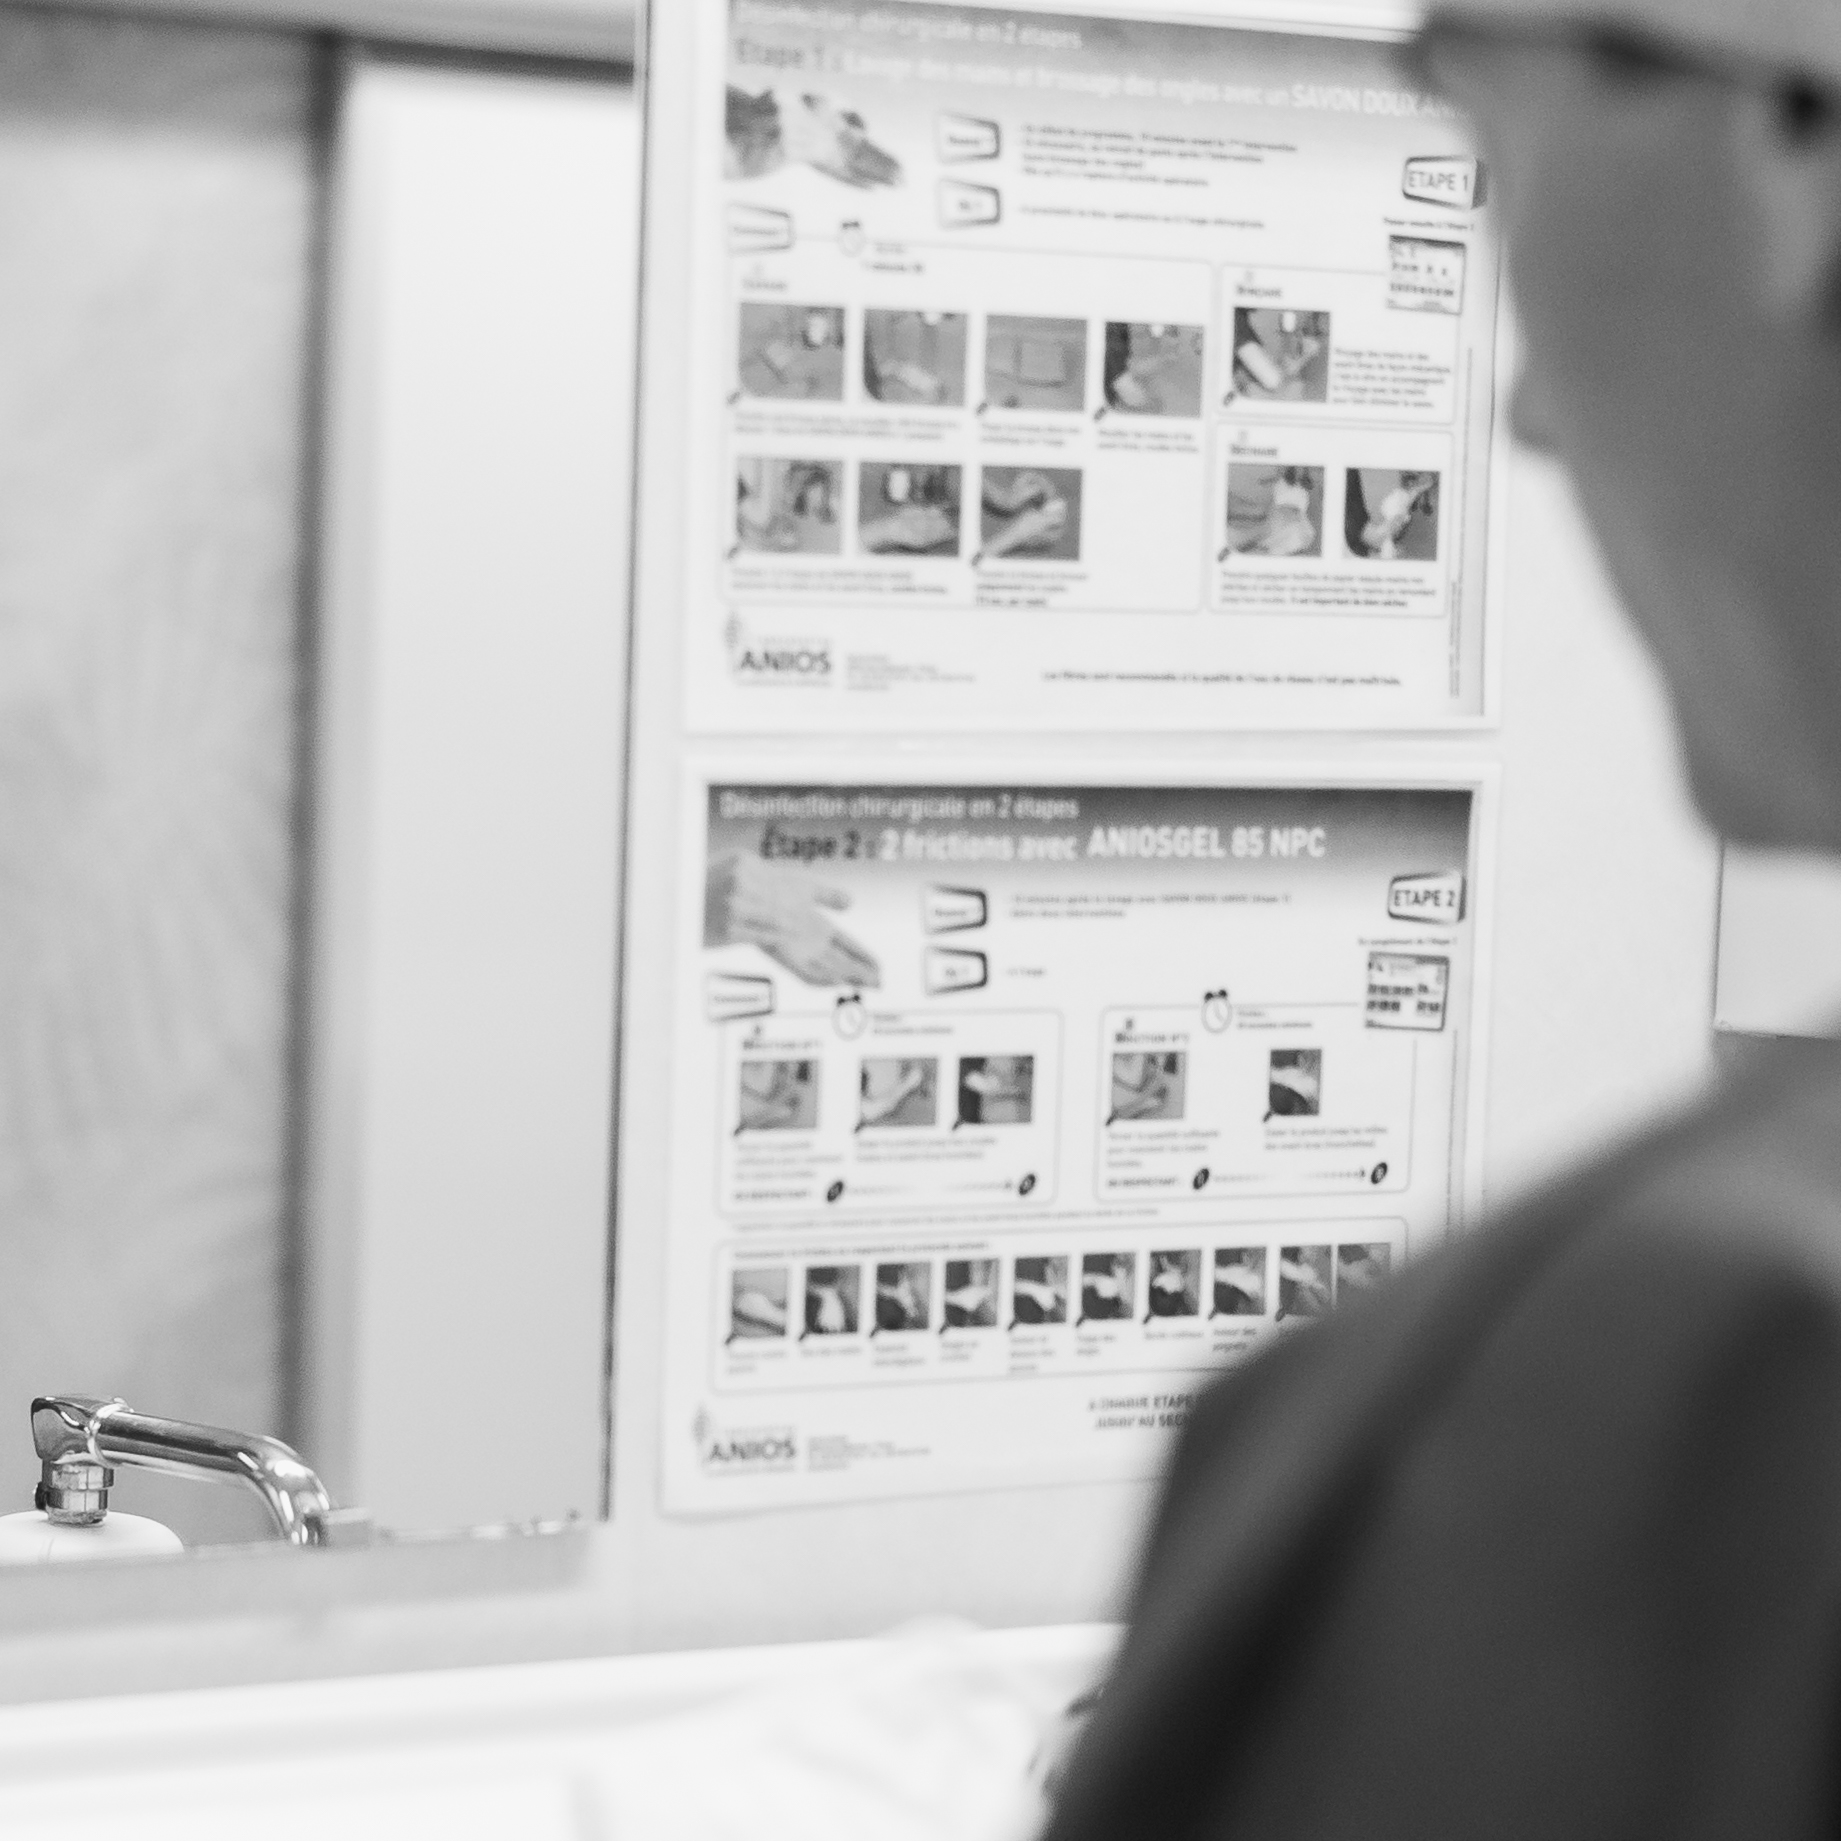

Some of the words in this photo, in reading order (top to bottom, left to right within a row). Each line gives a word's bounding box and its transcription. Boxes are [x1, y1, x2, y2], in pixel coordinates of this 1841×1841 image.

[1291, 82, 1362, 115] SAVON
[1363, 89, 1419, 117] DOUX
[1462, 174, 1470, 192] 1
[739, 649, 832, 675] ANIOS
[998, 793, 1011, 820] 2
[844, 829, 861, 860] 2
[880, 827, 900, 861] 2
[1018, 835, 1078, 860] avec
[1086, 825, 1226, 860] ANIOSGEL
[1231, 827, 1264, 859] 85
[1269, 827, 1326, 859] NPC
[1445, 890, 1456, 908] 2
[709, 1438, 796, 1462] ANIOS
